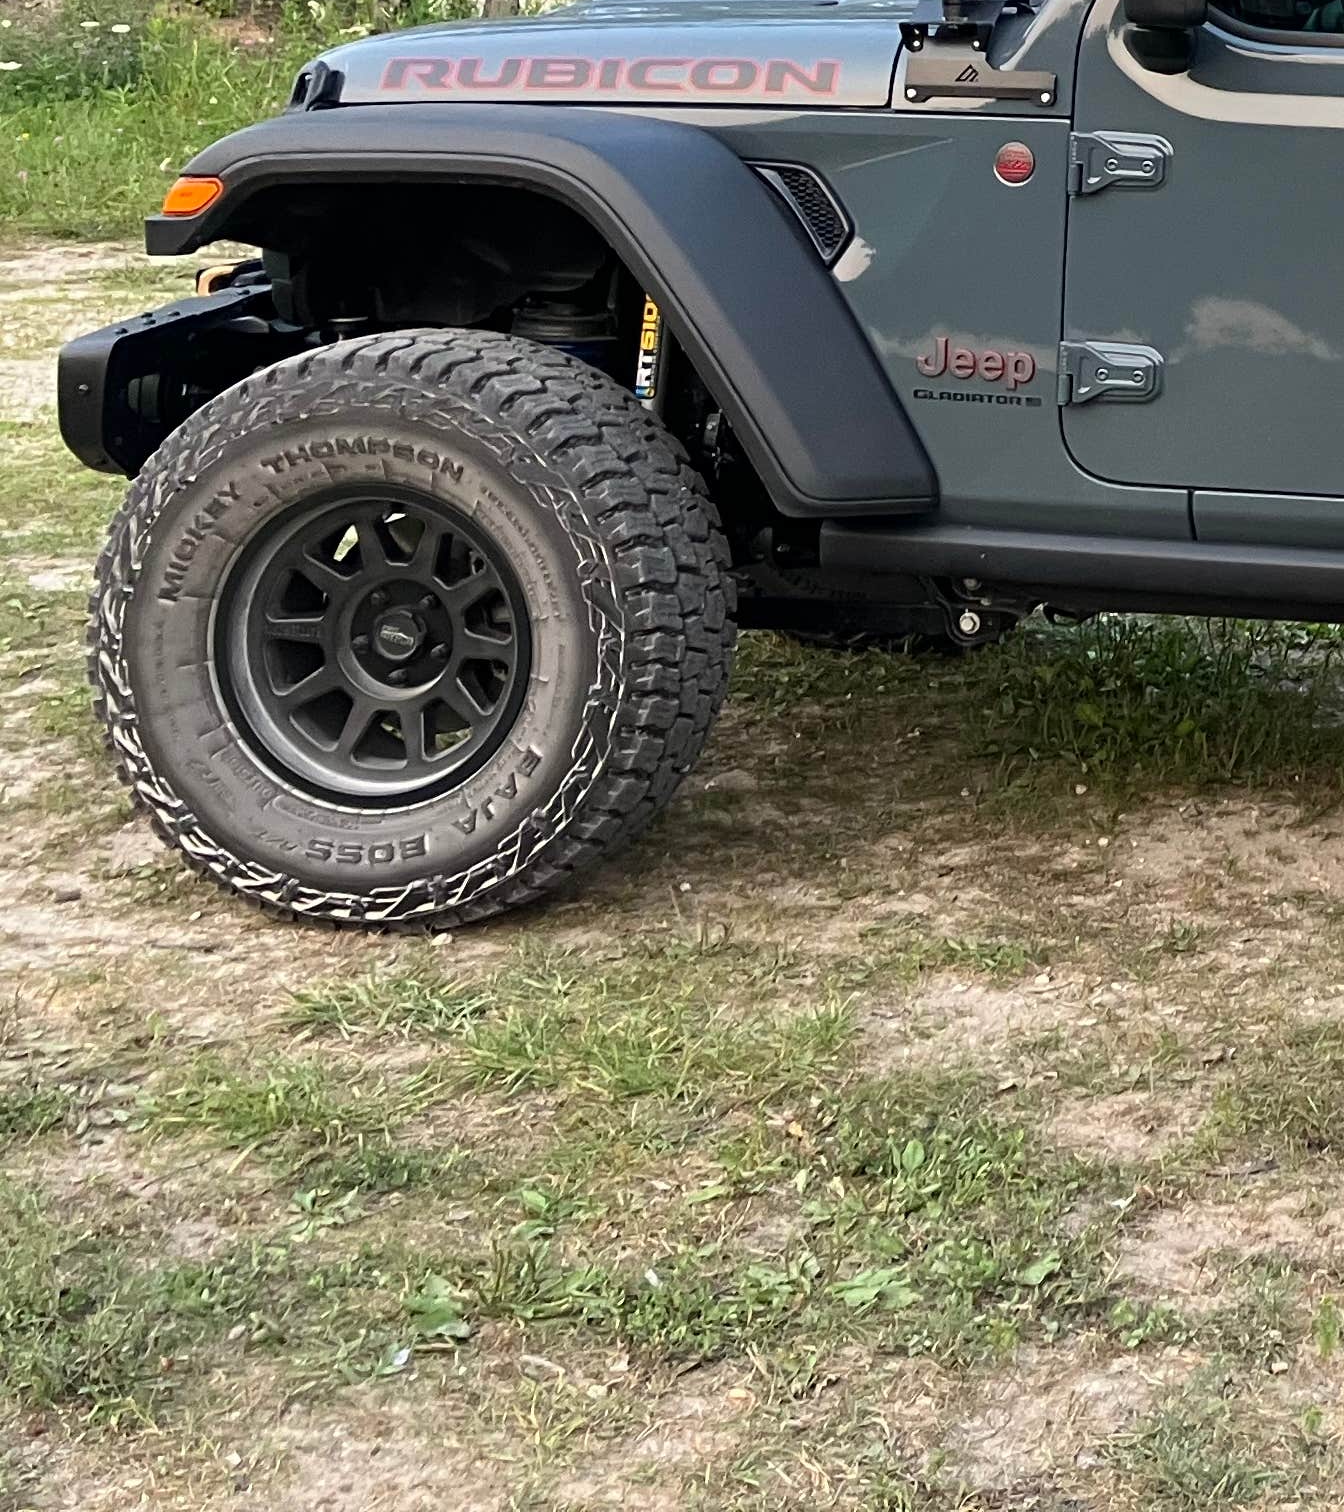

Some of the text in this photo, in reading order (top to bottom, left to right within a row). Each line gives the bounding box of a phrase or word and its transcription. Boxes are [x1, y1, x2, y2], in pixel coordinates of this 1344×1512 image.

[376, 55, 843, 98] RUBICON
[916, 336, 1036, 392] Jeep
[912, 388, 1023, 407] GLADIATOR
[259, 436, 466, 485] THOMPSON
[454, 743, 543, 836] BAJA
[304, 832, 430, 867] BOSS
